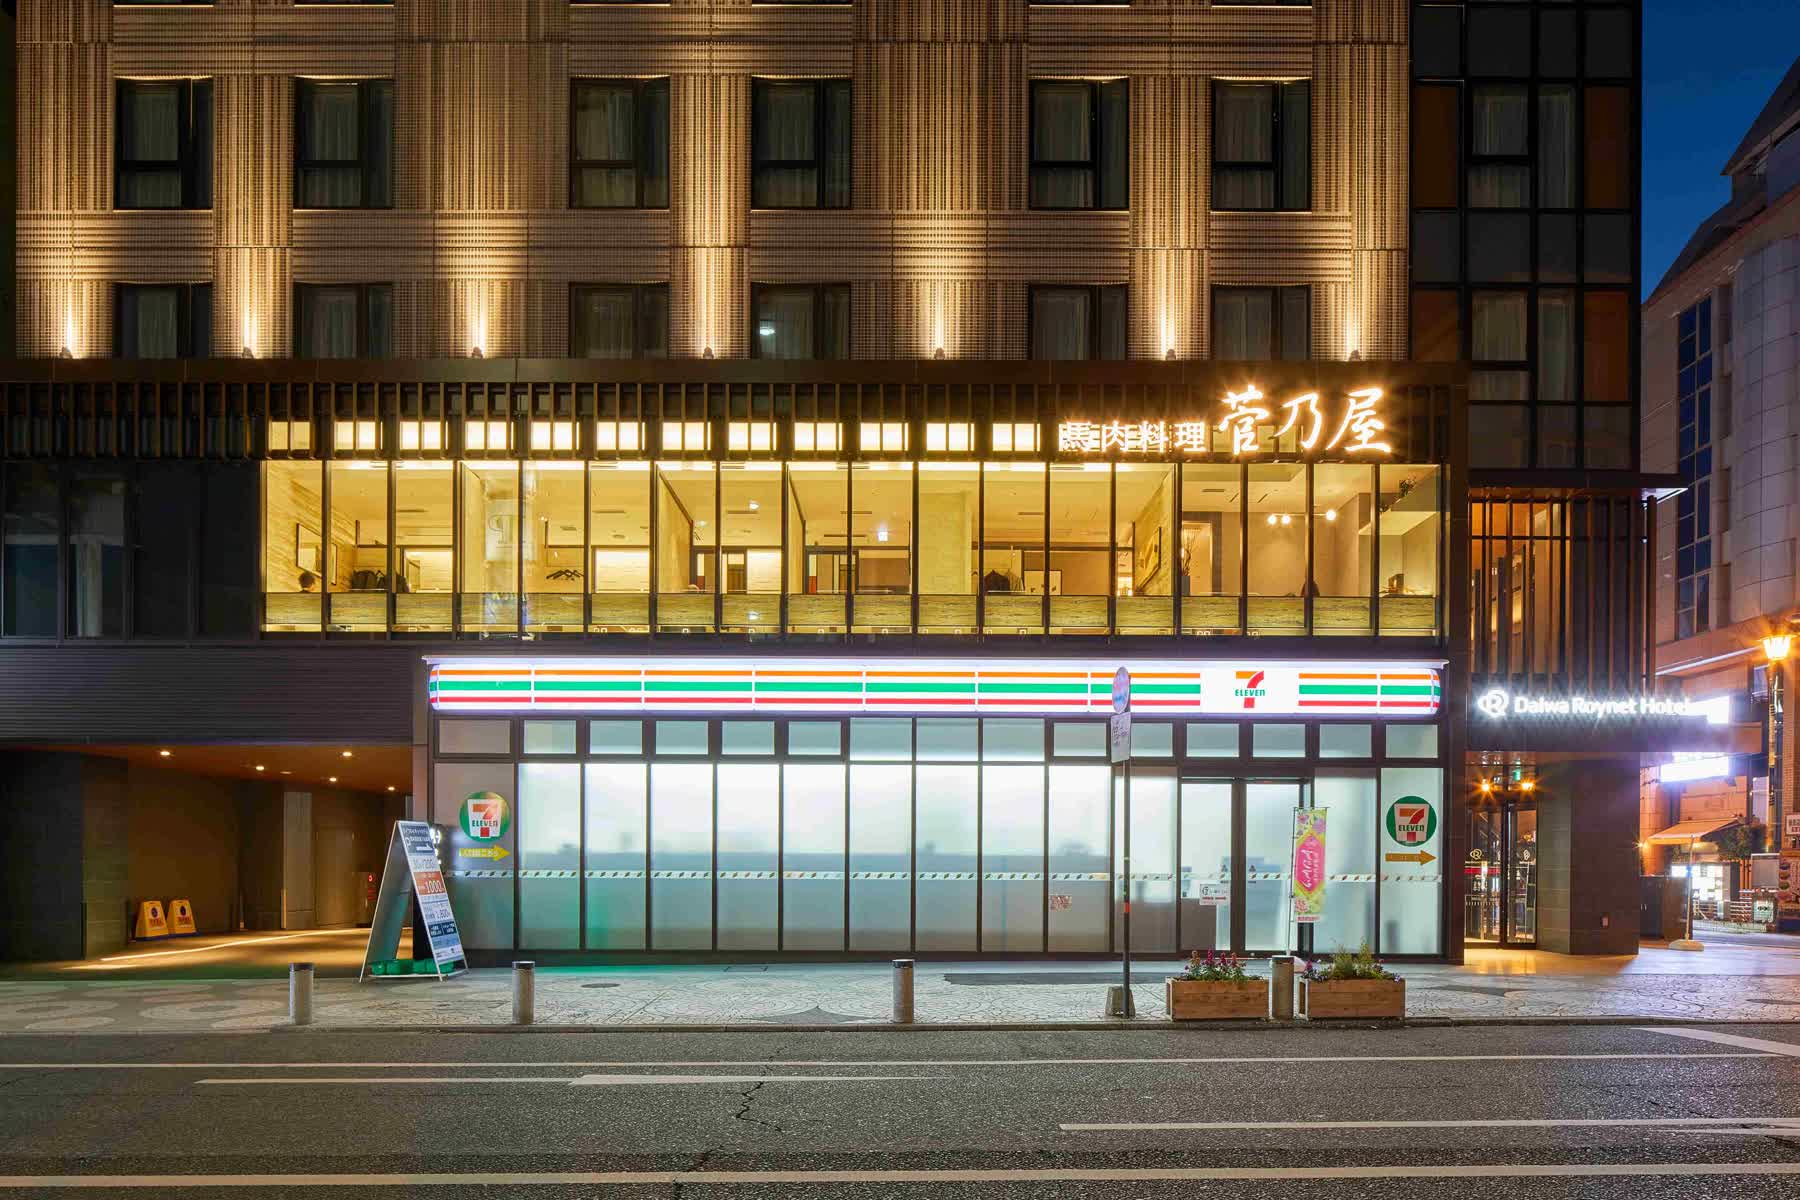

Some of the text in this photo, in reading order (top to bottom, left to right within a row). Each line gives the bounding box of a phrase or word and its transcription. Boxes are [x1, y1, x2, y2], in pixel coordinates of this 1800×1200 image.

[1064, 419, 1207, 453] 馬肉料理
[1218, 384, 1392, 455] 菅乃屋
[1235, 670, 1265, 709] 7
[1514, 697, 1569, 714] Daiwa
[1571, 697, 1636, 719] Roynet
[472, 803, 499, 838] 7
[1399, 808, 1425, 842] 7
